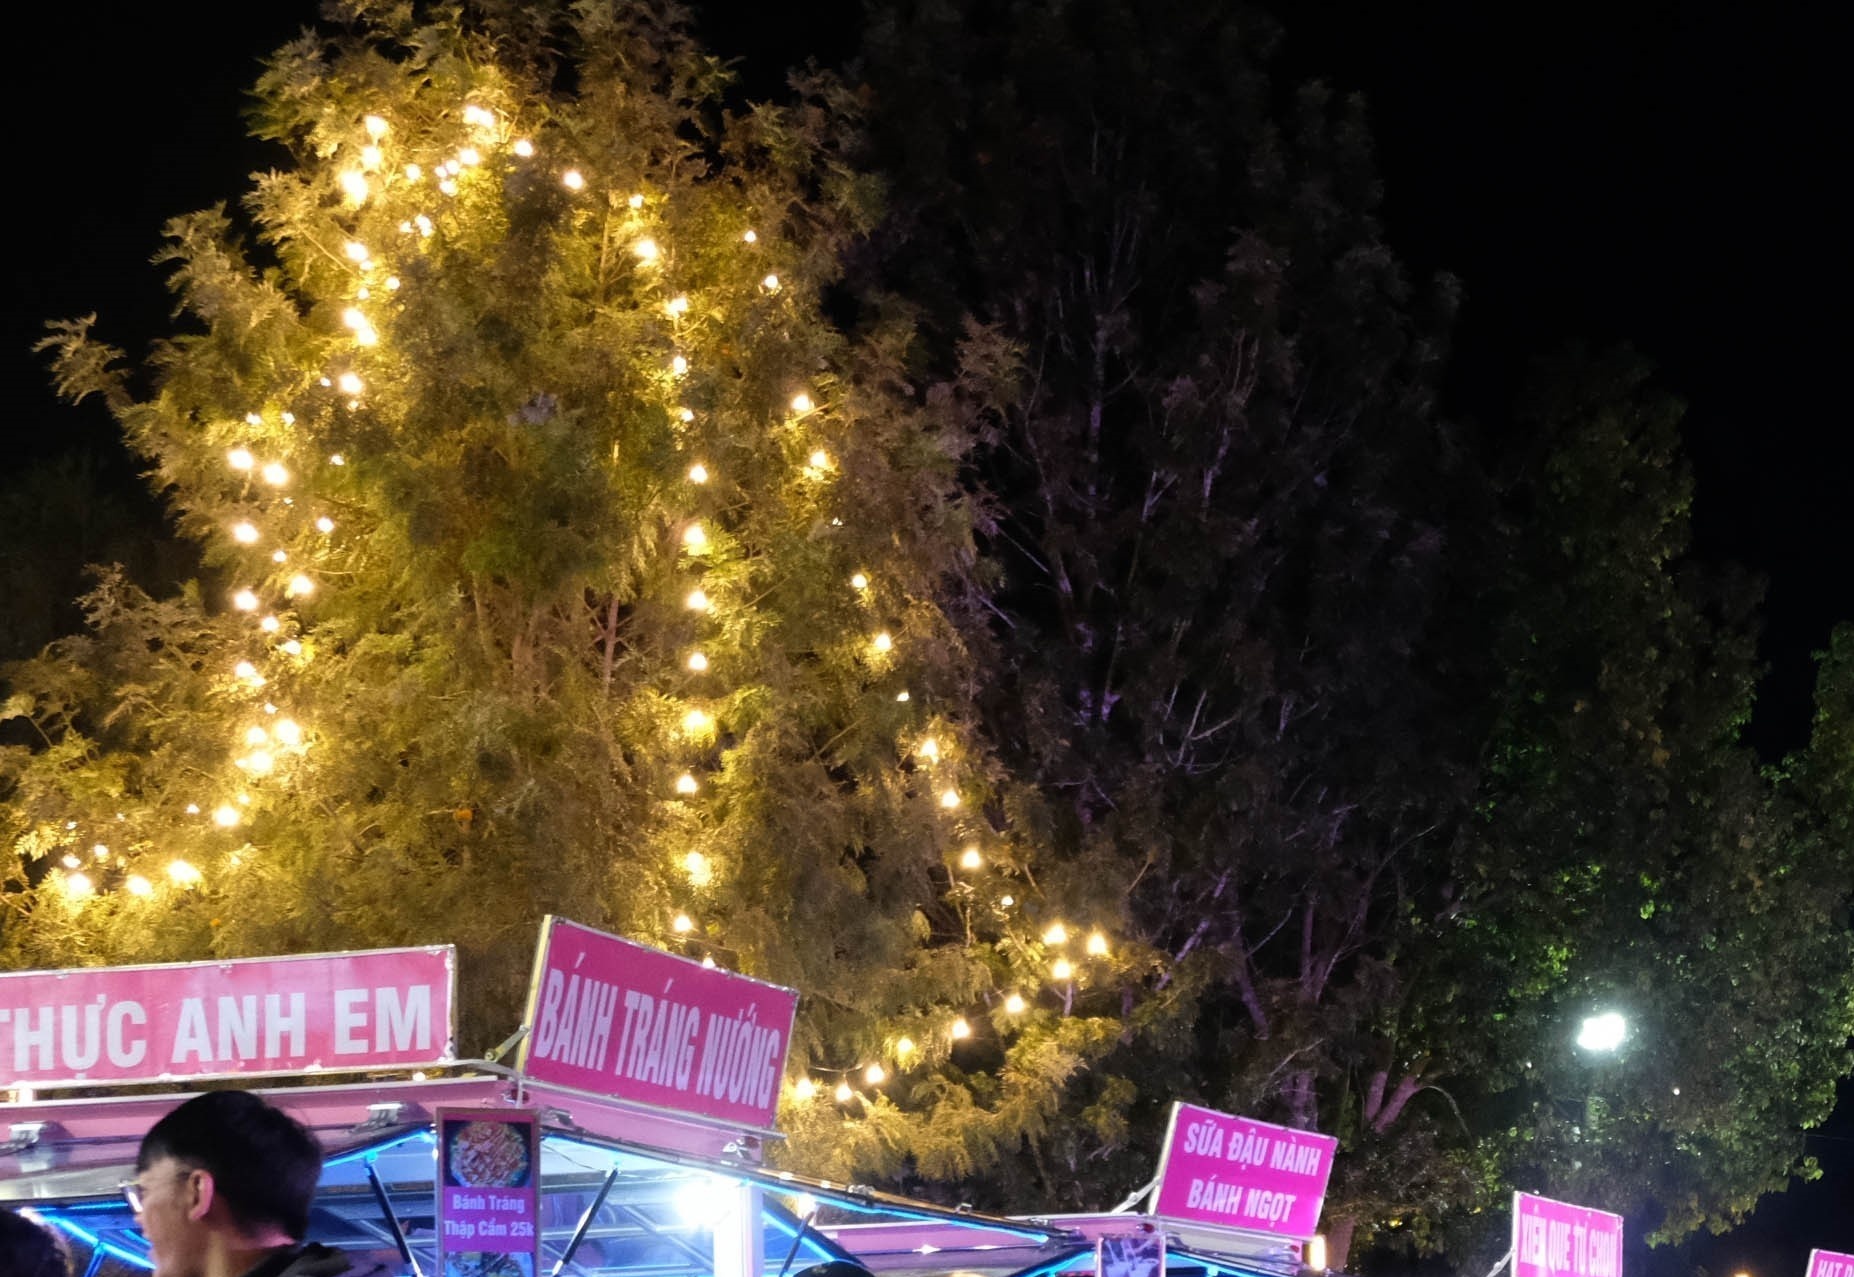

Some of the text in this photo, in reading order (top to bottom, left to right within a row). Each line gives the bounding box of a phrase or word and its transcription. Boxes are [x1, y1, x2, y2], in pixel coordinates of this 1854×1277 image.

[171, 993, 306, 1063] ANH
[334, 985, 431, 1055] EM
[534, 952, 781, 1109] BÁNH TRÁNG NƯỚNG
[1184, 1119, 1322, 1176] SỮA ĐẬU NÀNH
[452, 1194, 525, 1214] Bánh Tráng
[1186, 1174, 1297, 1227] BÁNH NGỌT
[444, 1220, 475, 1239] Thập
[510, 1221, 534, 1236] 25k
[1548, 1219, 1571, 1276] QUE
